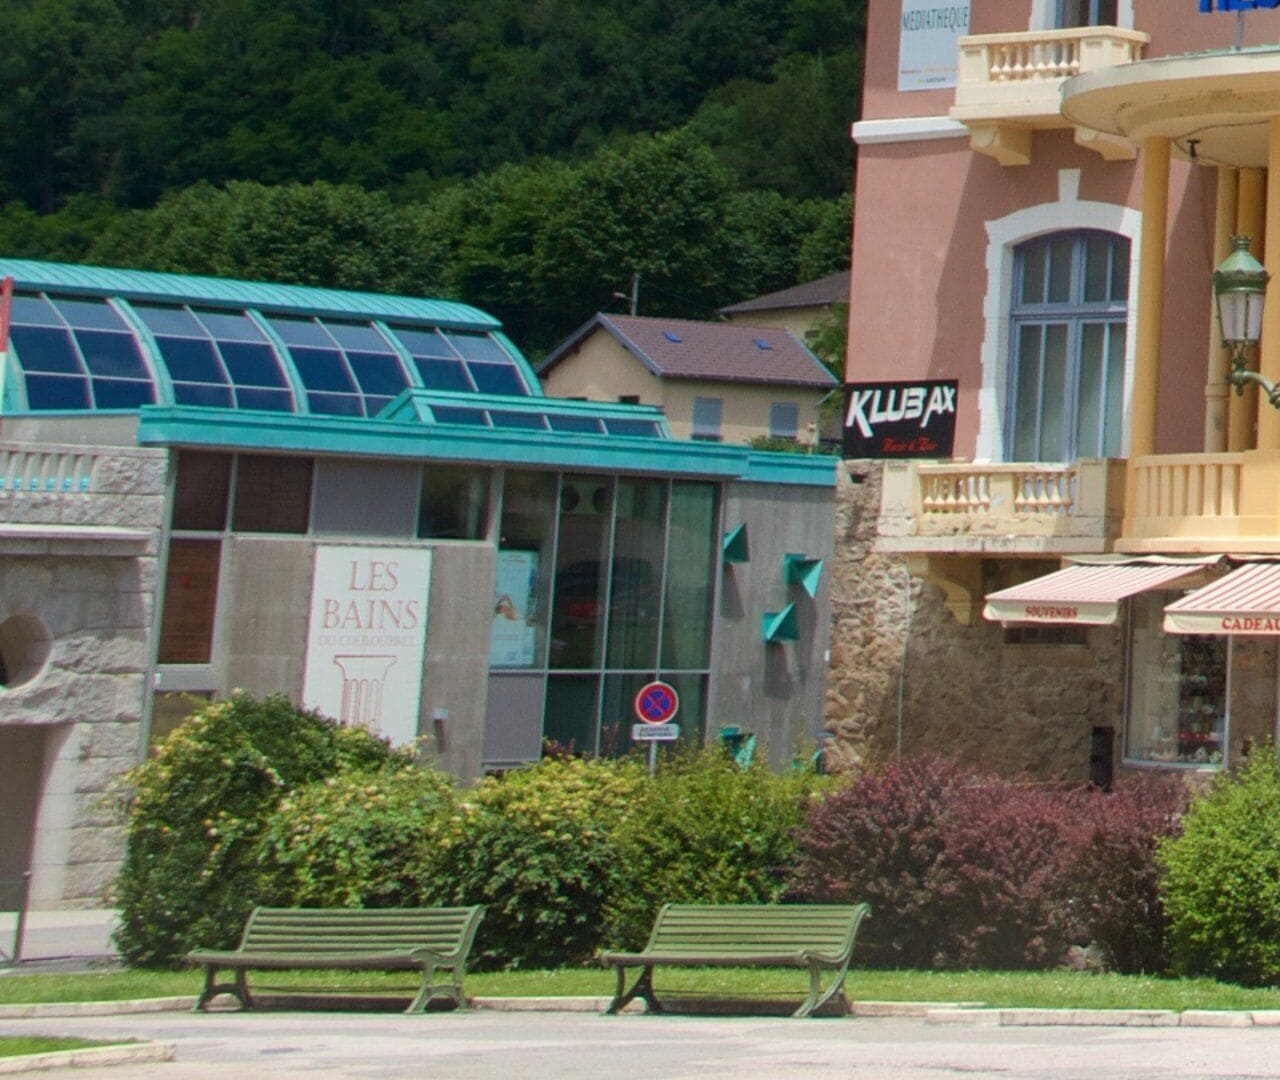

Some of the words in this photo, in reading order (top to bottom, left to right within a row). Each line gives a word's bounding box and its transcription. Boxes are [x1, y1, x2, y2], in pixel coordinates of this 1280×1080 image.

[349, 560, 399, 591] LES
[323, 599, 418, 630] BAINS
[1025, 606, 1079, 619] SOUVENIRS
